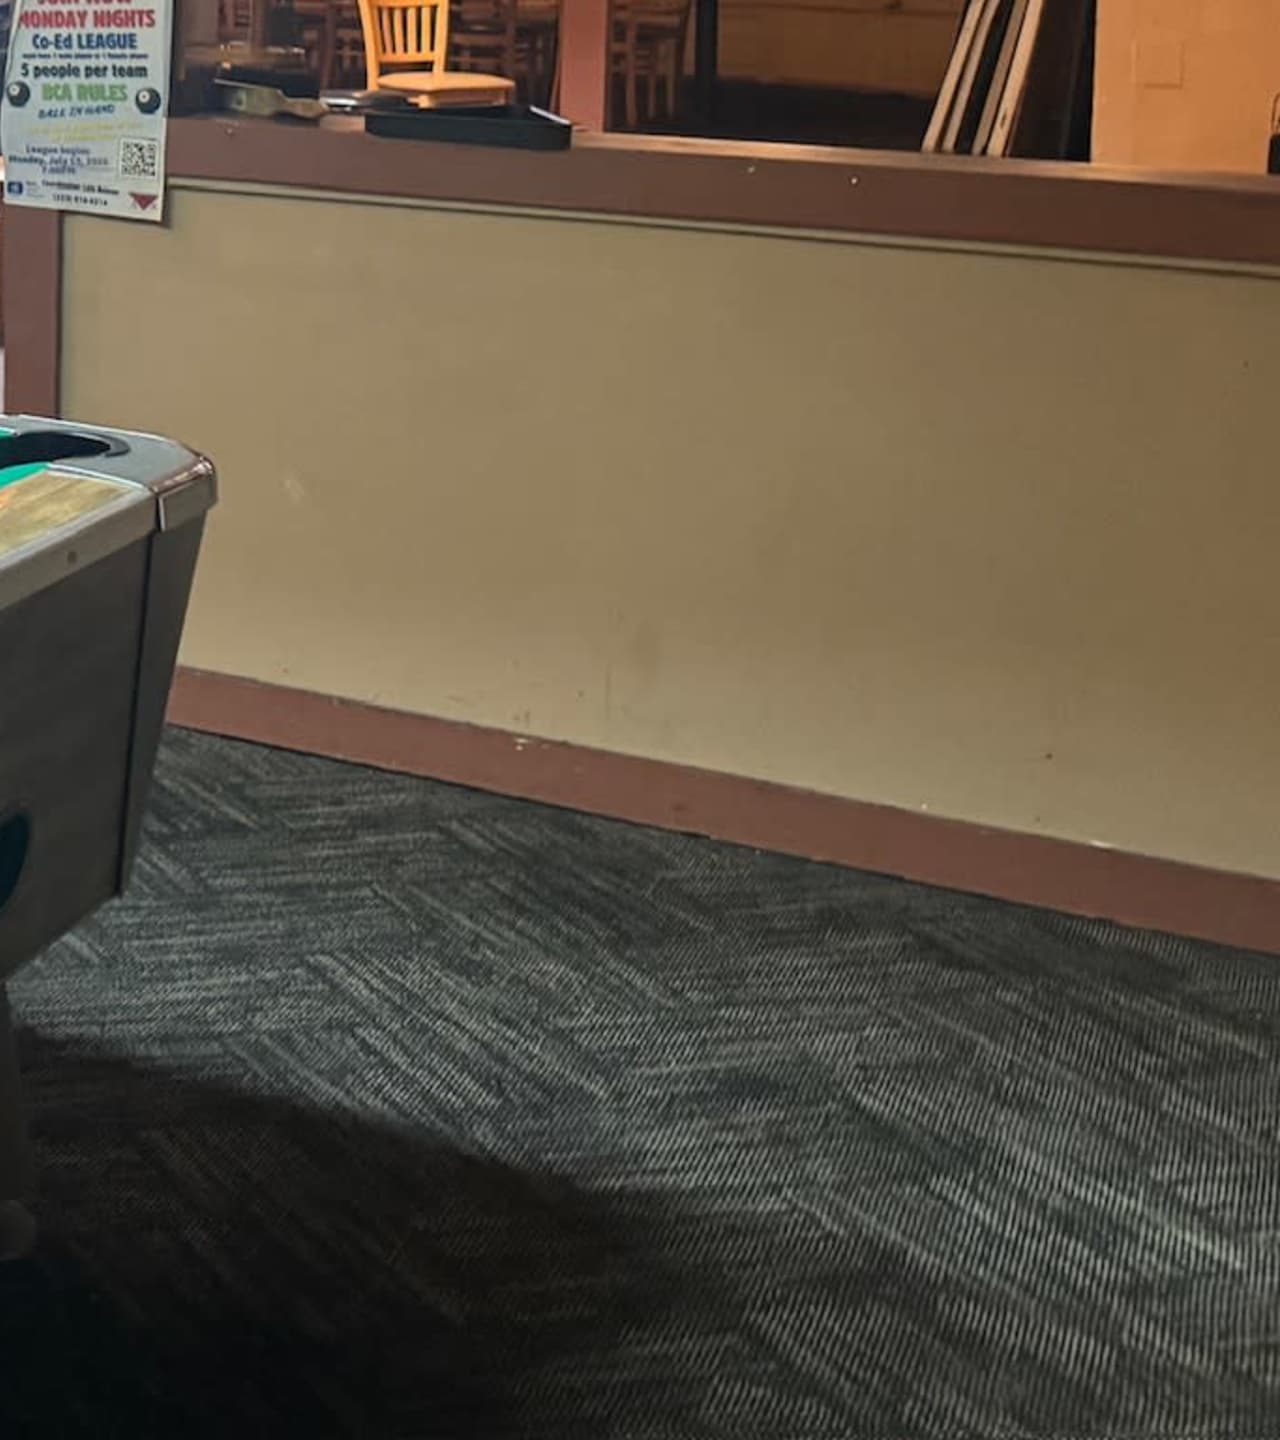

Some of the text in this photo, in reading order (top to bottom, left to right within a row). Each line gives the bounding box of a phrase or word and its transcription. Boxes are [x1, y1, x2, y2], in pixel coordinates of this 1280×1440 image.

[19, 9, 156, 29] MONDAY NIGHTS
[32, 33, 137, 49] Co-Ed LEAGUE
[21, 62, 148, 78] 5 people per team
[78, 84, 128, 101] RULES
